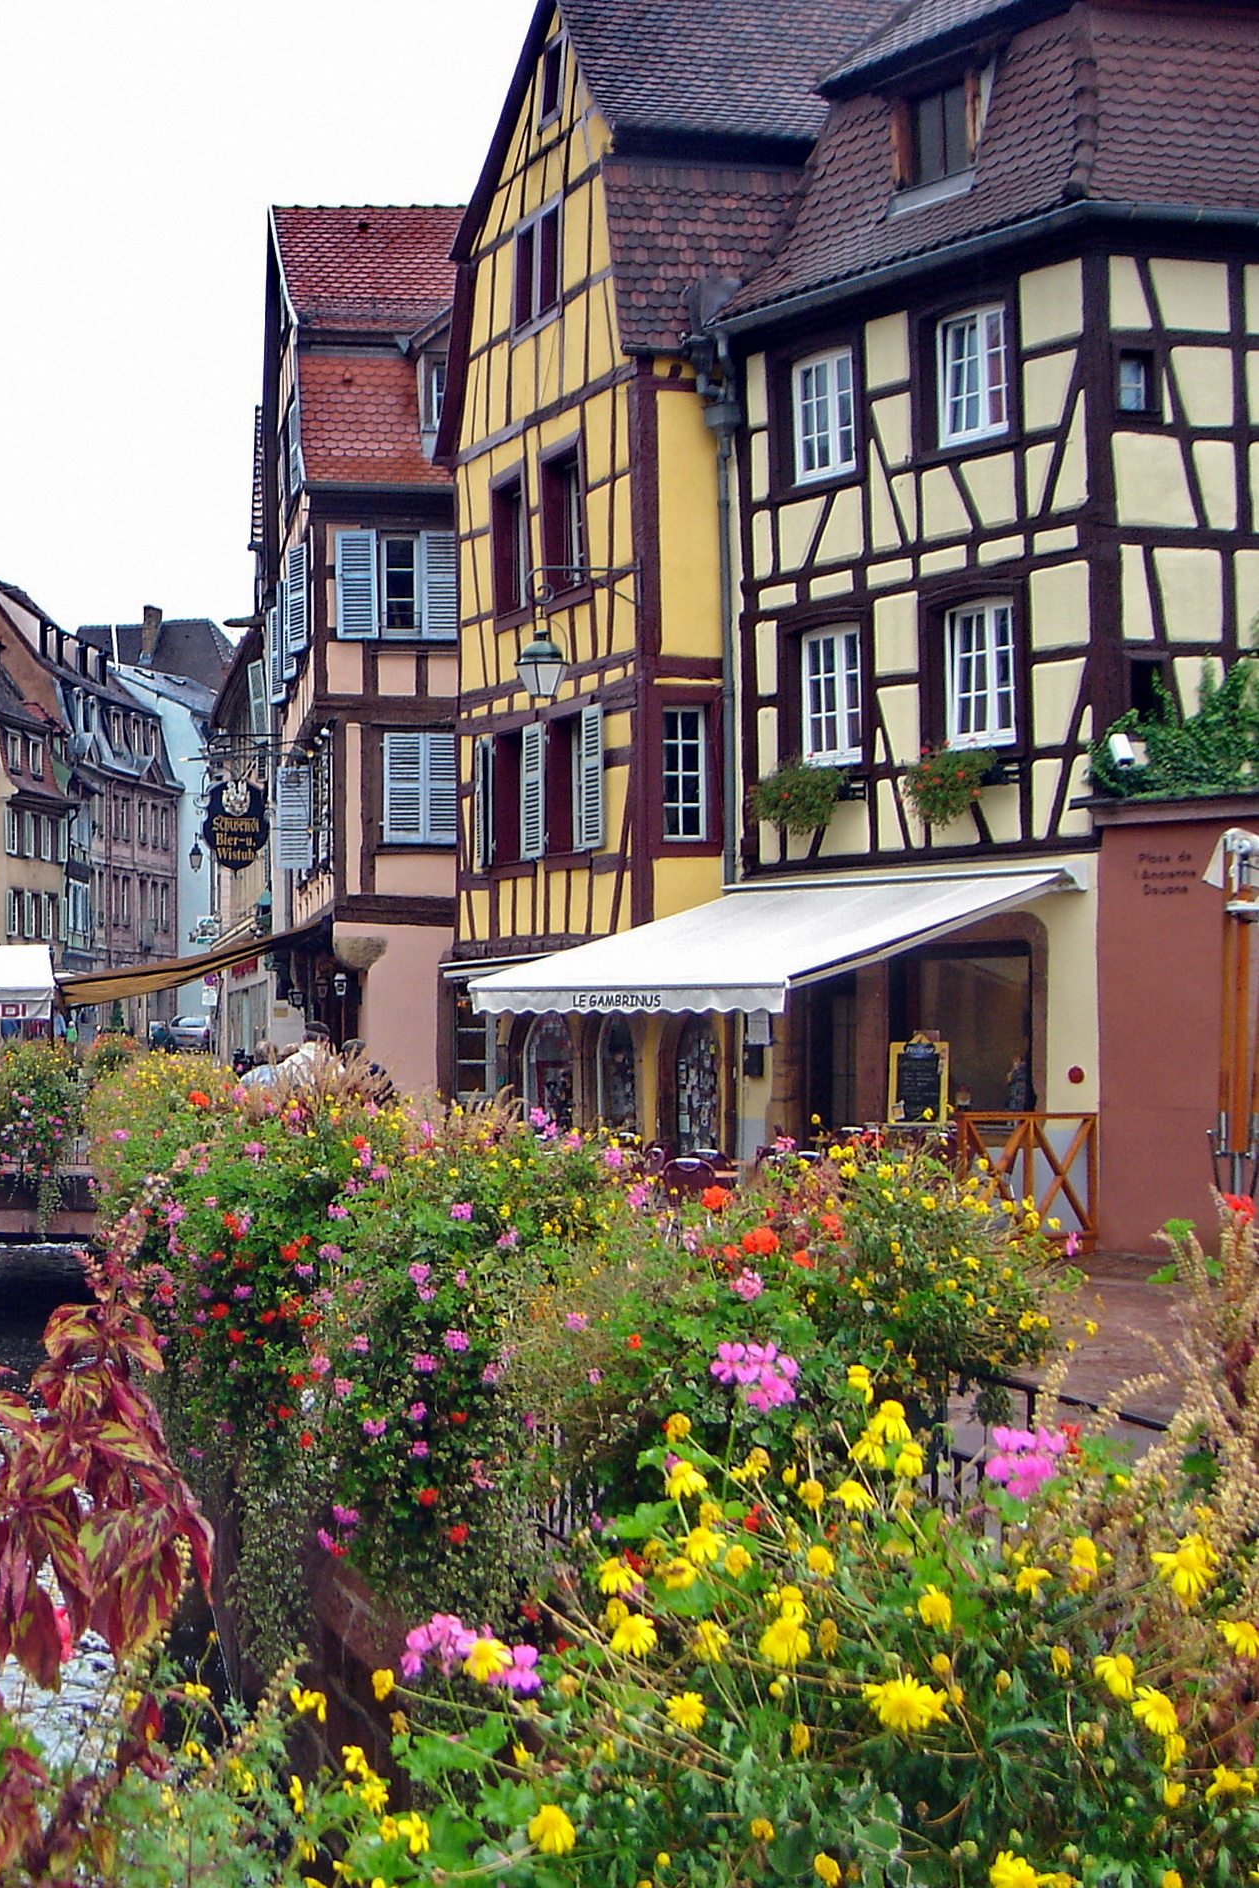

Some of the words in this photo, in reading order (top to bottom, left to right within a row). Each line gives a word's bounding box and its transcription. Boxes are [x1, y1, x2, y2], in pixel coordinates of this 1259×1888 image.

[212, 815, 260, 832] Schwendi
[216, 847, 255, 861] Wistub
[572, 994, 586, 1007] LE
[589, 994, 661, 1008] GAMBRINUS
